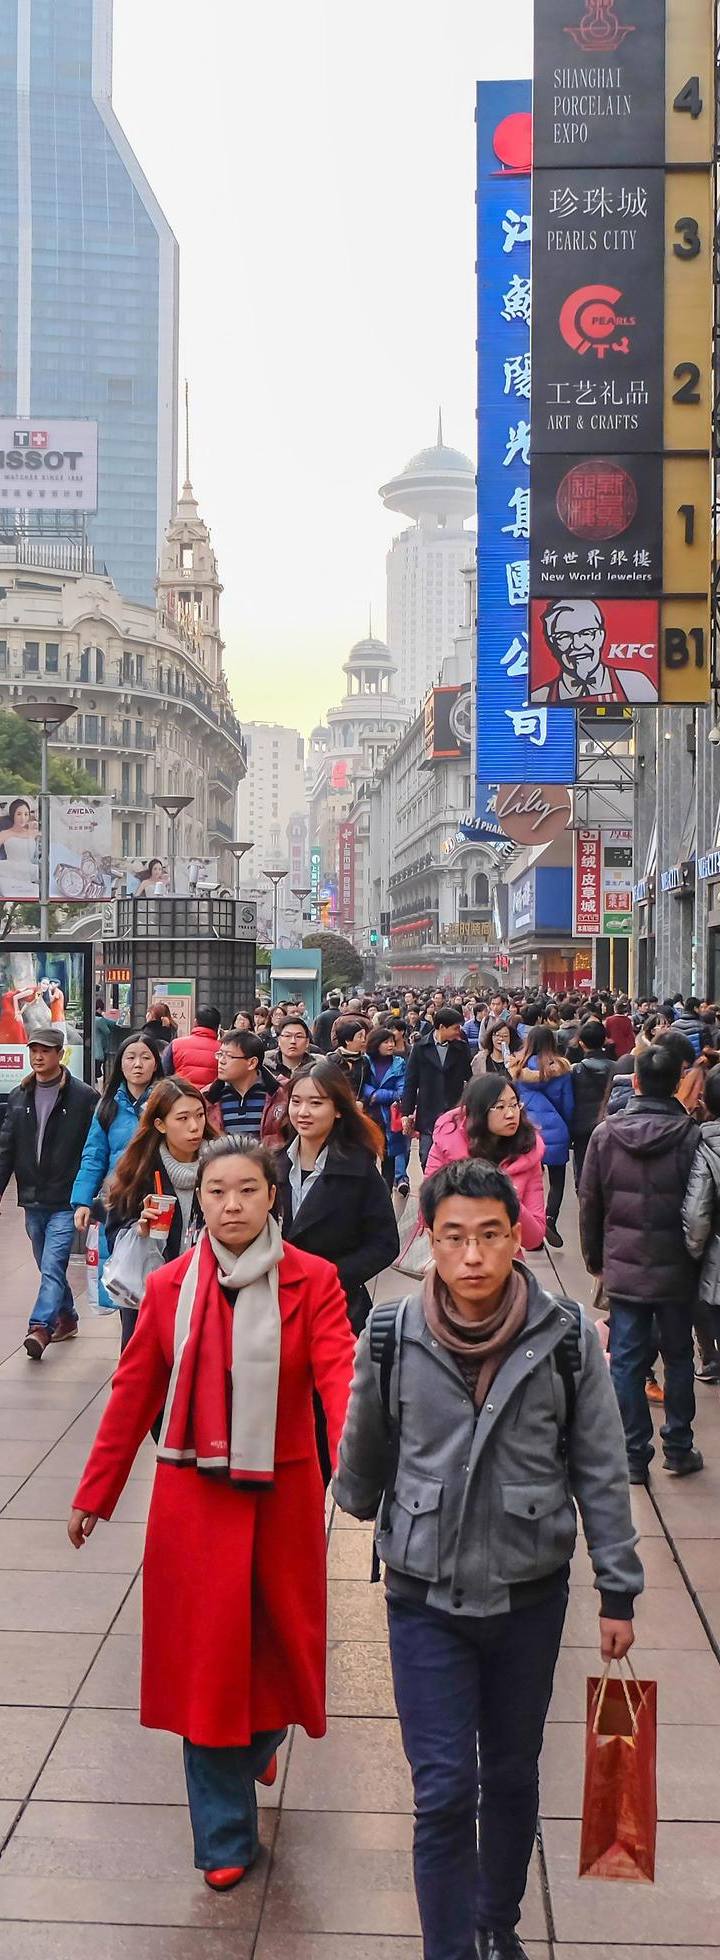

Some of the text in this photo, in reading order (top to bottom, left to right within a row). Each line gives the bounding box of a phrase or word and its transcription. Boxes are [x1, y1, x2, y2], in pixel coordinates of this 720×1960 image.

[553, 68, 624, 89] SHANGHAI
[553, 95, 632, 116] PORCELAIN
[673, 76, 703, 120] 4
[553, 123, 588, 143] EXPO
[549, 186, 648, 218] 珍珠城
[546, 230, 637, 250] PEARLS CITY
[672, 217, 701, 261] 3
[591, 316, 637, 326] PEARLS
[546, 380, 648, 405] 工艺礼品
[672, 362, 701, 404] 2
[547, 414, 639, 430] ART & CRAFTS
[677, 504, 695, 545] 1
[540, 549, 652, 569] 新世界銀樓
[541, 572, 652, 581] New World Jewelers
[607, 643, 656, 659] KFC
[664, 627, 704, 670] B1
[497, 784, 571, 831] Lily
[458, 813, 481, 829] NO.1
[577, 914, 599, 922] SALE
